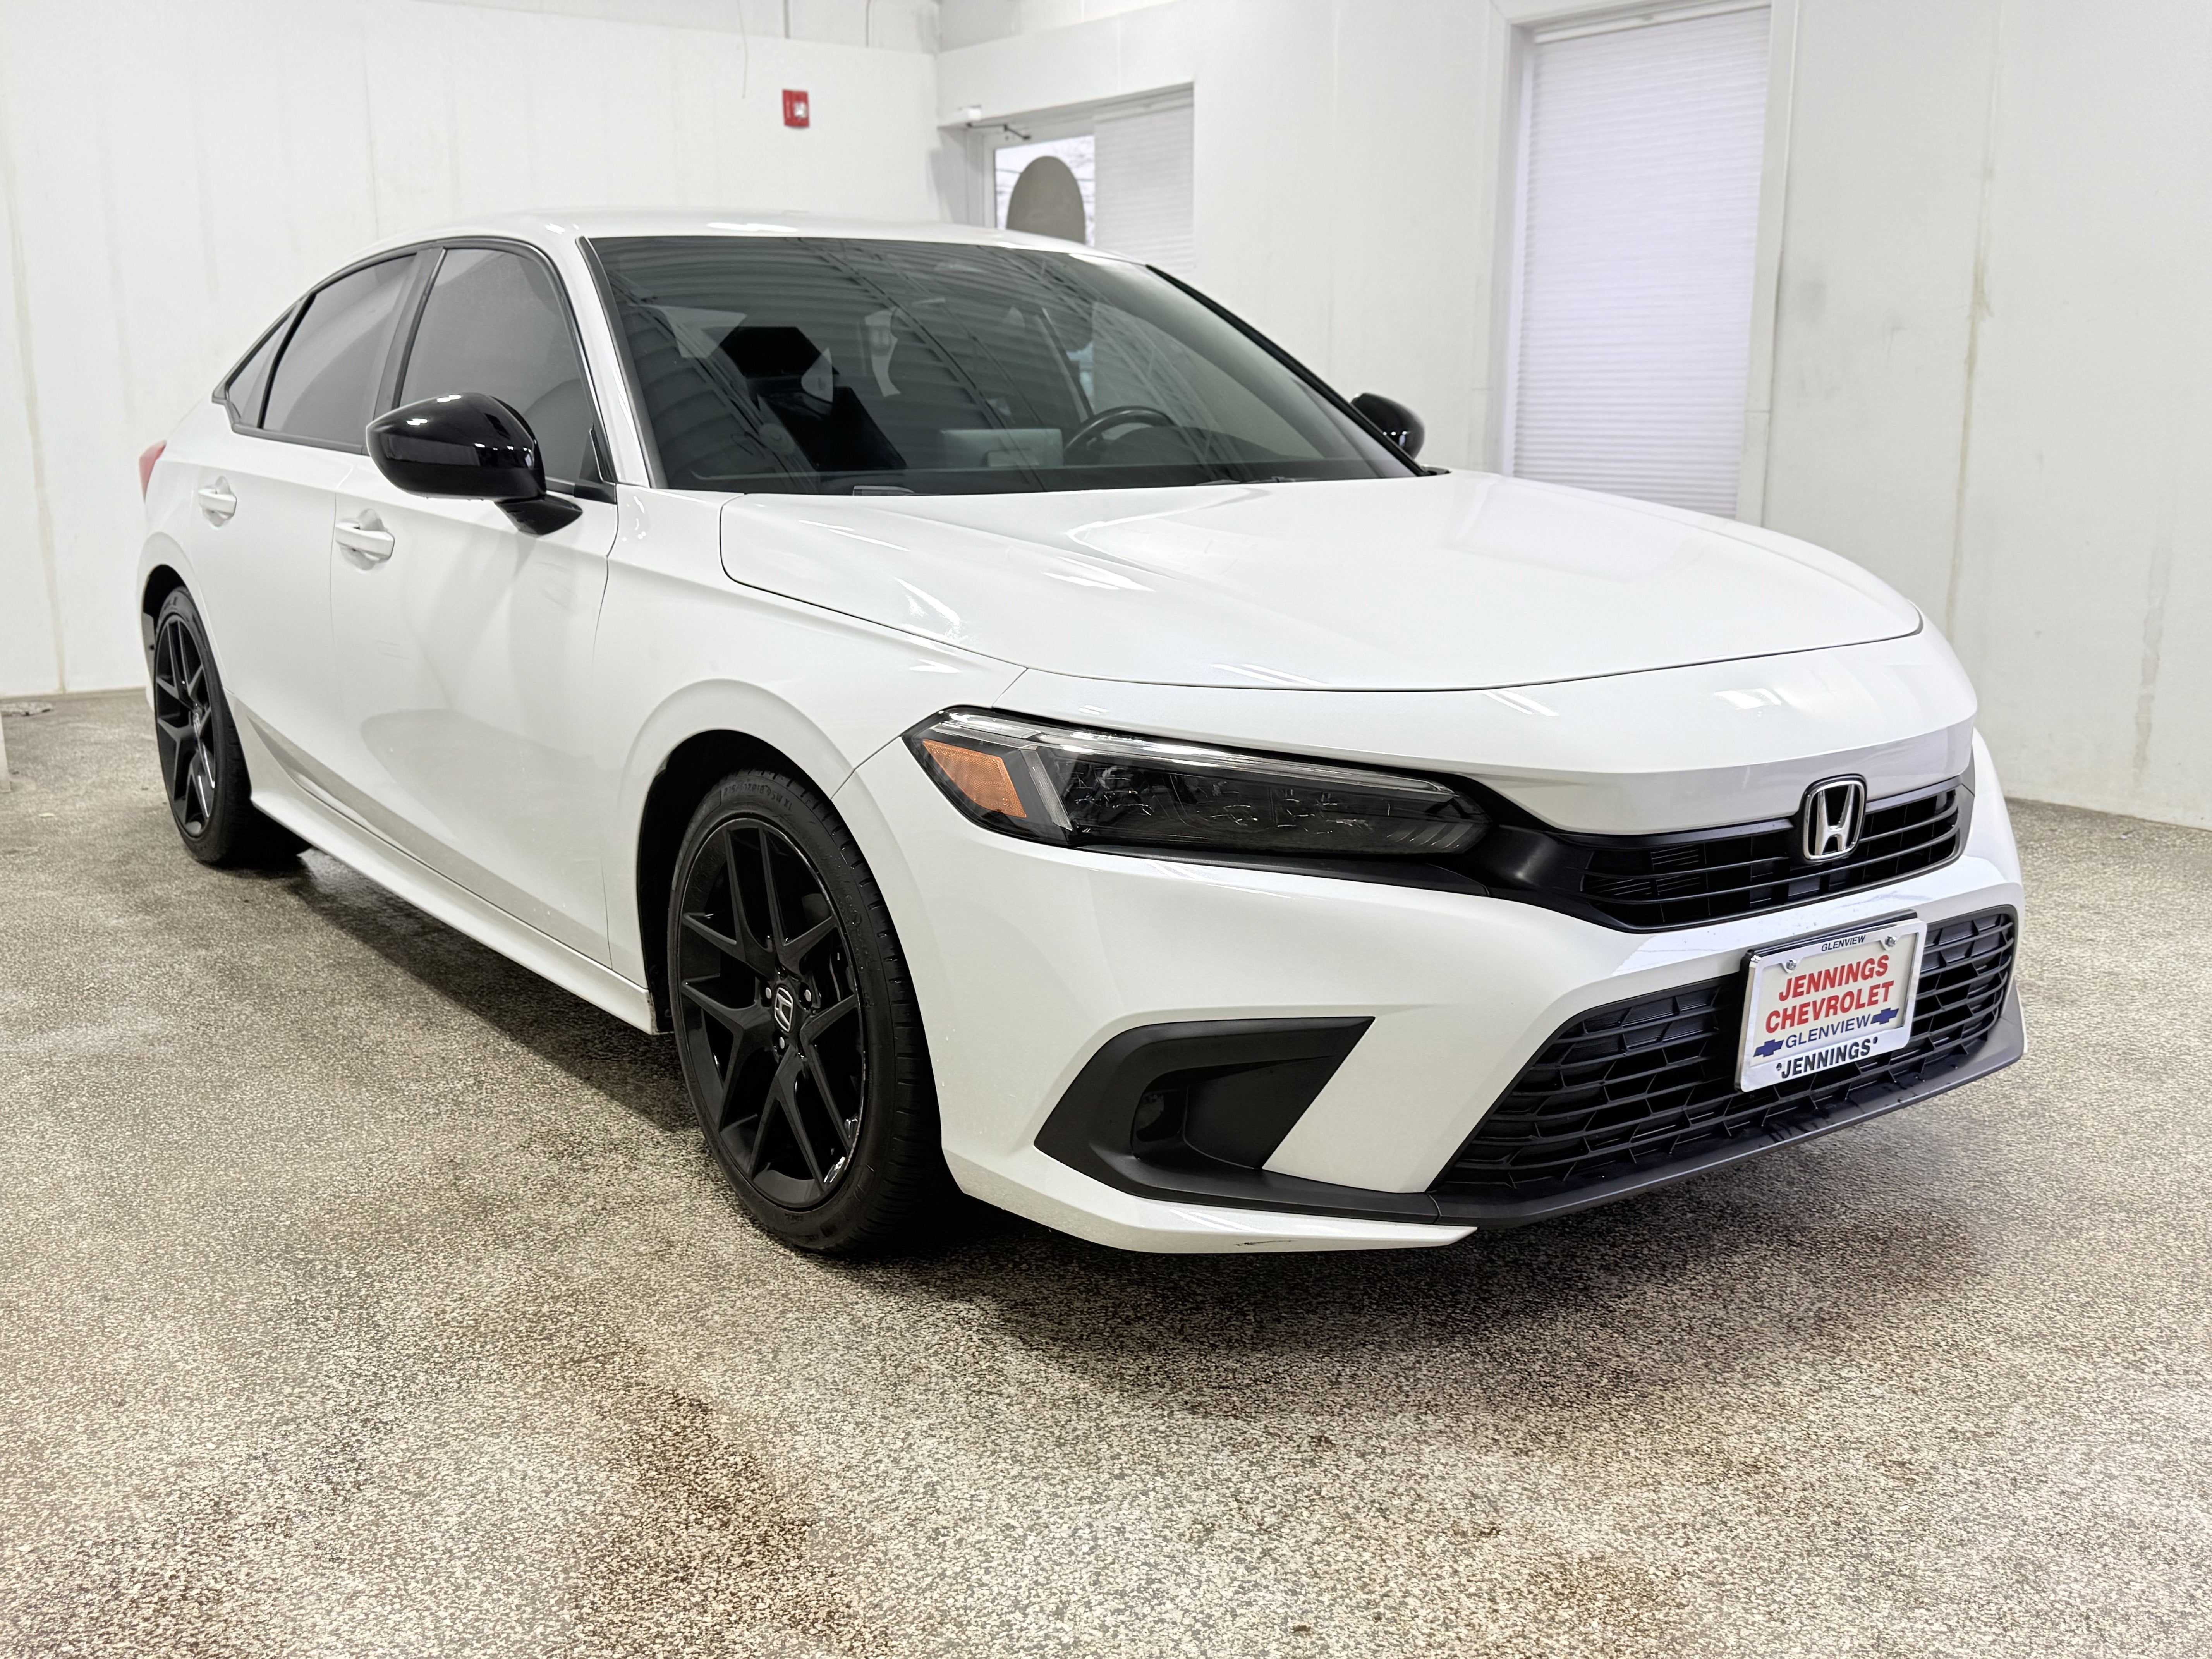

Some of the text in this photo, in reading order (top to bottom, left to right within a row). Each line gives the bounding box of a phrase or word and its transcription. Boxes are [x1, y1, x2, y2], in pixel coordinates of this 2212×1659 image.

[1821, 935, 1865, 951] GLENVIEW
[1779, 955, 1889, 1001] JENNINGS
[1765, 981, 1894, 1033] CHEVROLET
[1785, 1014, 1871, 1048] GLENVIEW
[1781, 1038, 1871, 1079] JENNINGS
